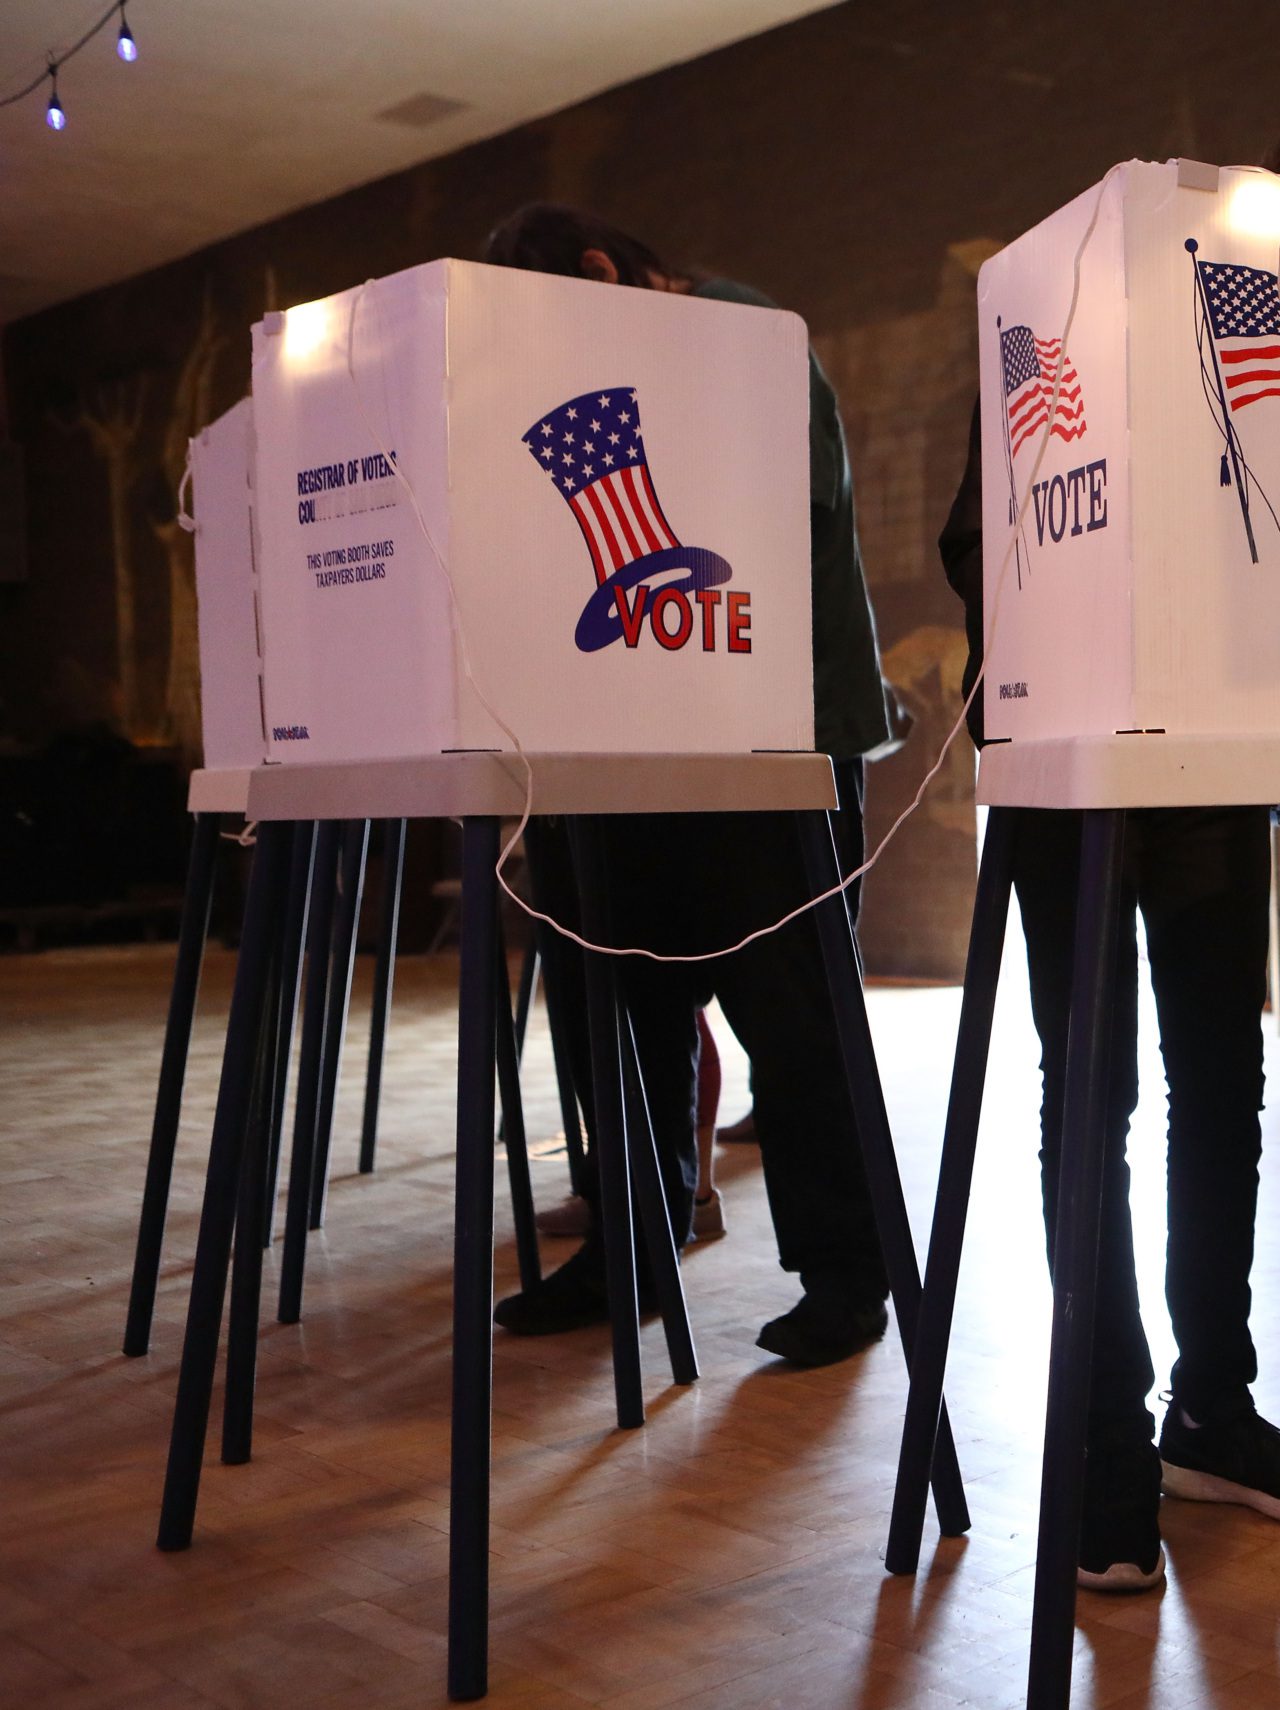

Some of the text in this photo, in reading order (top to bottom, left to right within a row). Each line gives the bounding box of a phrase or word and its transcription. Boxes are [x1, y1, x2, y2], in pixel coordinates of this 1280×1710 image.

[297, 463, 345, 496] REGISTRAR
[347, 459, 358, 484] OF
[1032, 459, 1108, 546] VOTE
[306, 540, 394, 571] THIS VOTING BOOTH SAVES
[315, 562, 386, 589] TAXPAYERS DOLLARS
[614, 585, 752, 654] VOTE
